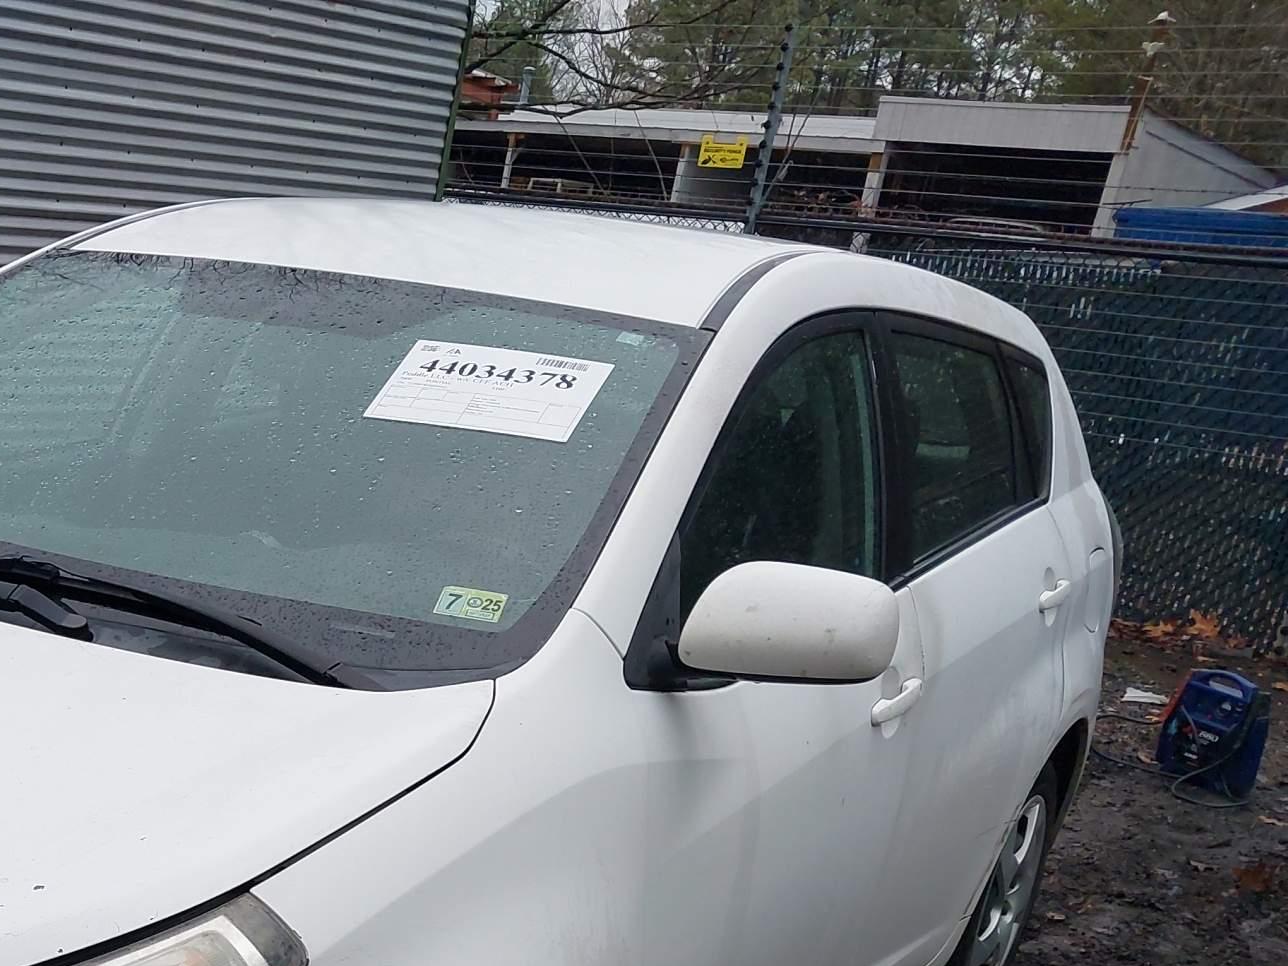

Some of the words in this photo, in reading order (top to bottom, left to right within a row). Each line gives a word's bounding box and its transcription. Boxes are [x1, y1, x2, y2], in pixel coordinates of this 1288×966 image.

[419, 359, 577, 389] 44034378
[445, 593, 463, 610] 7
[481, 598, 503, 612] 25
